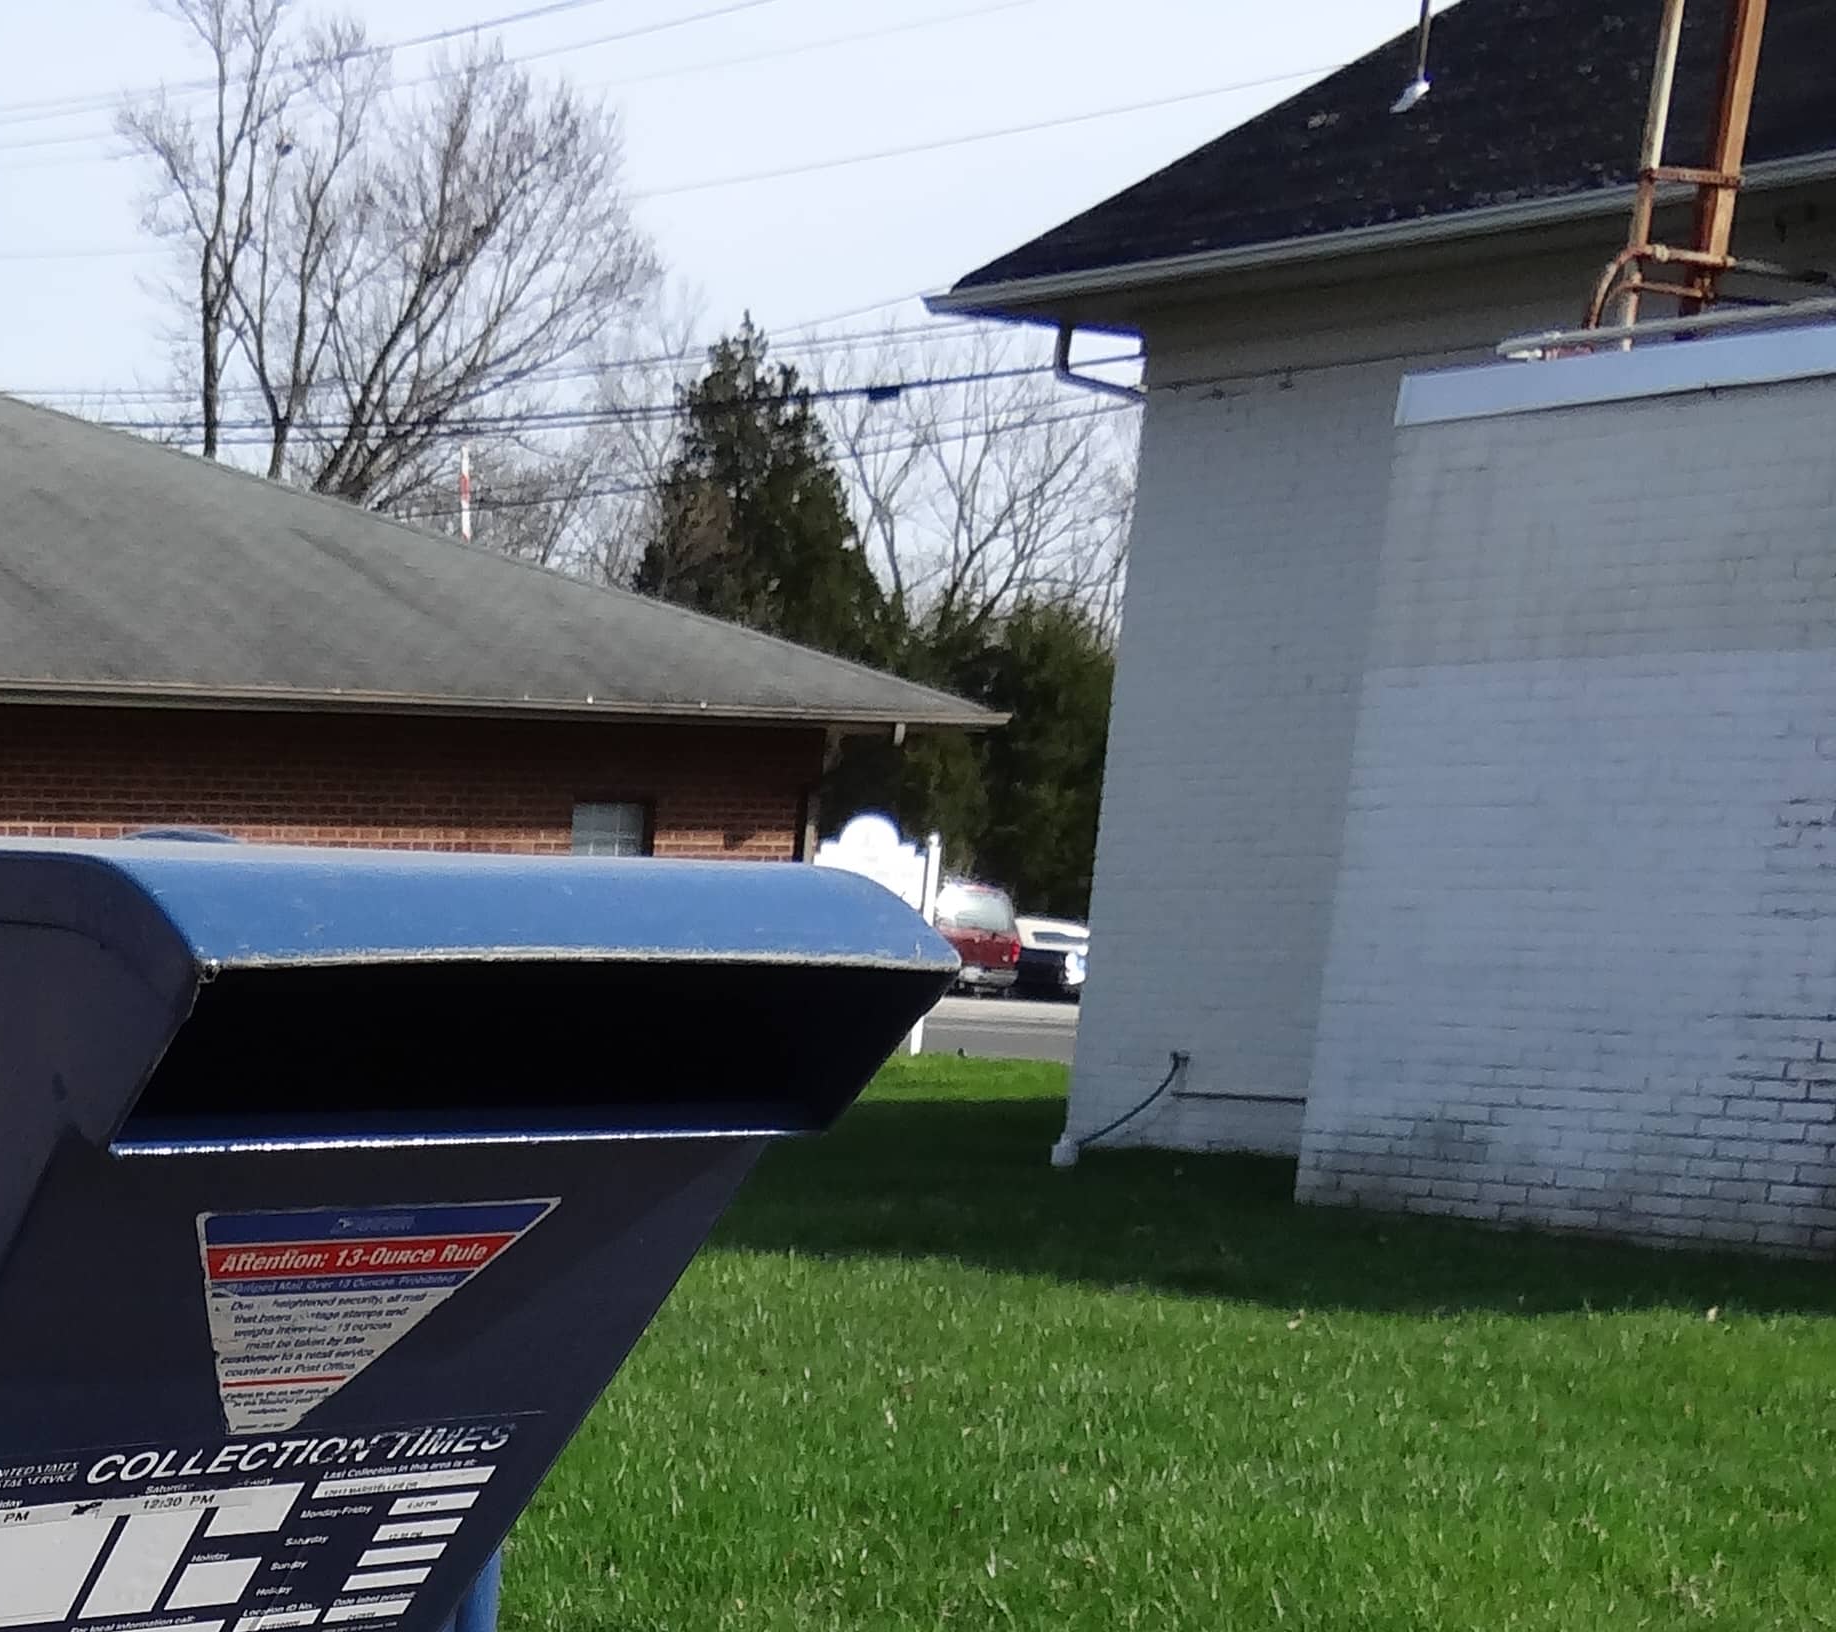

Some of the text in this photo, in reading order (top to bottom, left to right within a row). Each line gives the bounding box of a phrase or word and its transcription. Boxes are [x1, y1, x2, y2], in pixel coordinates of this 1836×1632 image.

[219, 1243, 489, 1273] Attention: 13-Ounce Rule
[87, 1424, 515, 1485] COLLECTION TIMES
[144, 1482, 195, 1495] Saturda
[143, 1494, 215, 1509] 12:30 PM
[3, 1511, 30, 1524] PM
